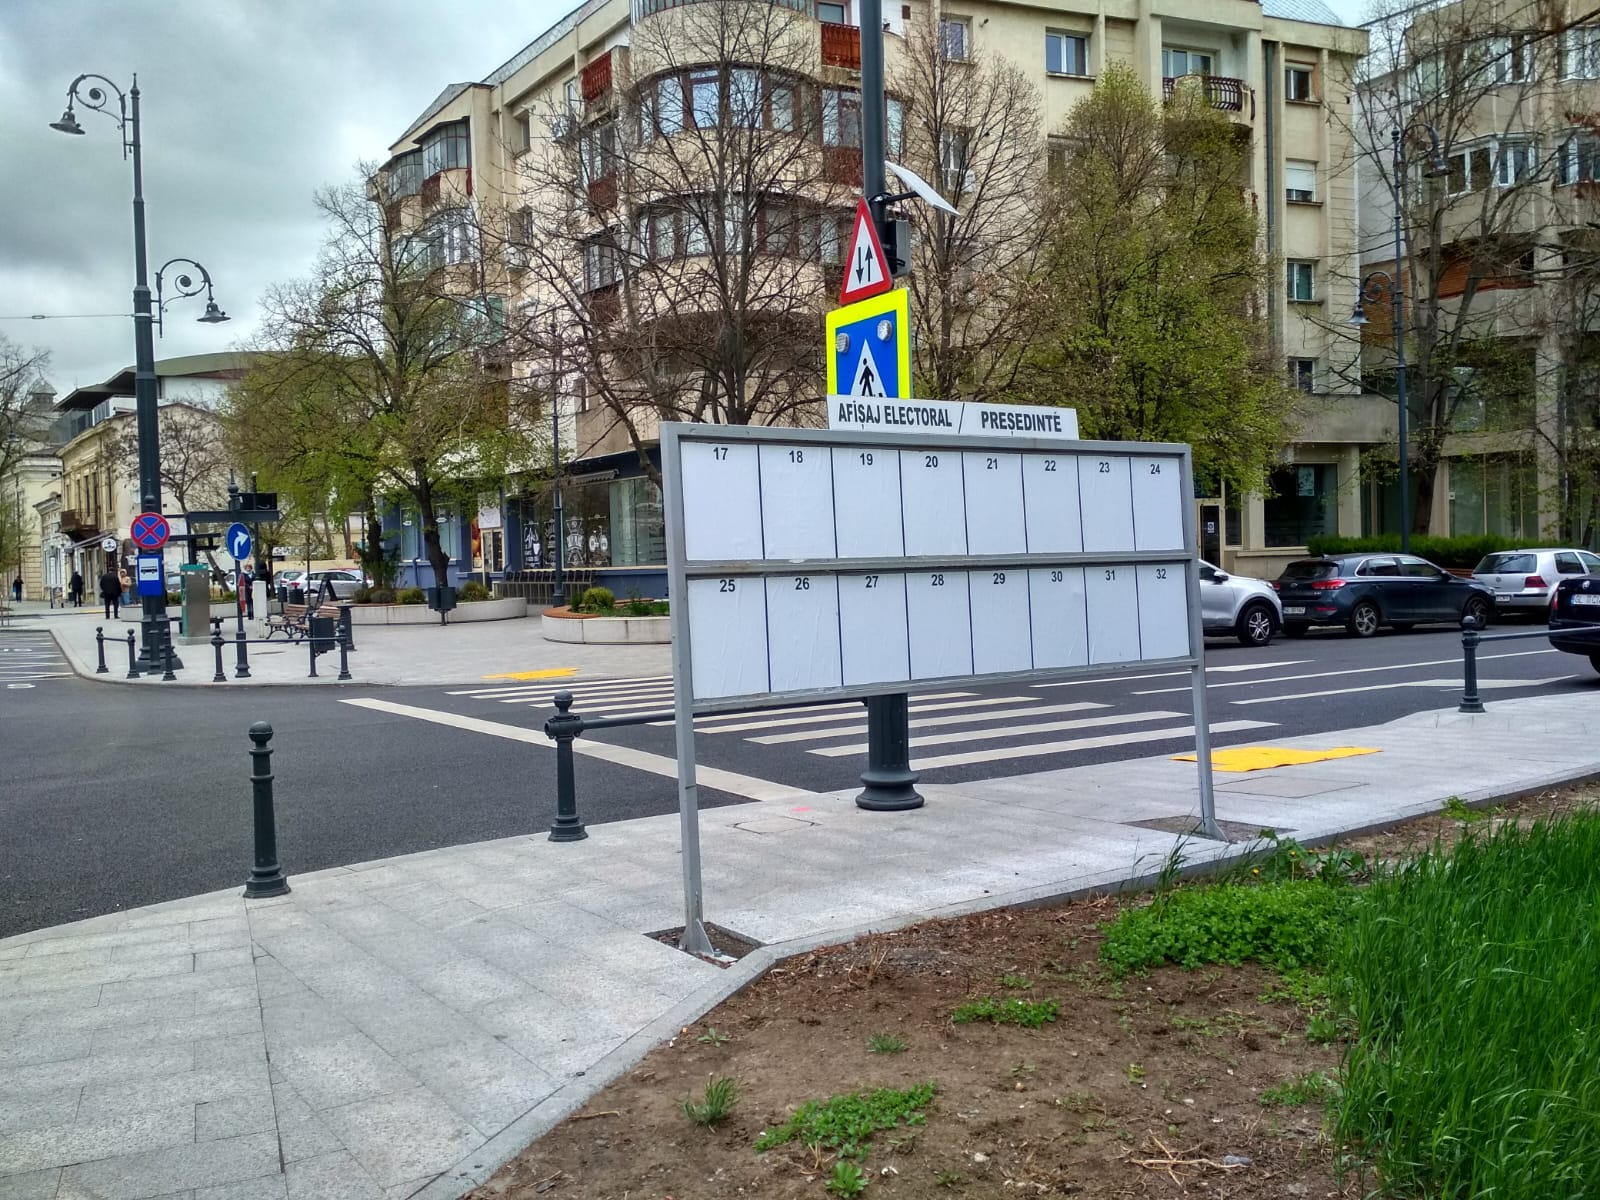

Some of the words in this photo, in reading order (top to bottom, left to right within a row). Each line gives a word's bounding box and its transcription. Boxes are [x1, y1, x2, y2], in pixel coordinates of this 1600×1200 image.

[884, 405, 953, 427] ELECTORAL
[713, 447, 729, 461] 17
[788, 450, 803, 464] 18
[859, 453, 873, 466] 19
[924, 455, 938, 468] 20
[986, 457, 998, 470] 21
[1044, 460, 1057, 472] 22
[1098, 462, 1110, 474] 23
[1149, 463, 1161, 475] 24
[931, 574, 944, 586] 28
[993, 573, 1005, 585] 29
[1051, 571, 1063, 583] 30
[1105, 569, 1116, 581] 31
[1156, 568, 1167, 580] 32
[719, 579, 735, 592] 25
[795, 577, 810, 590] 26
[865, 576, 879, 588] 27
